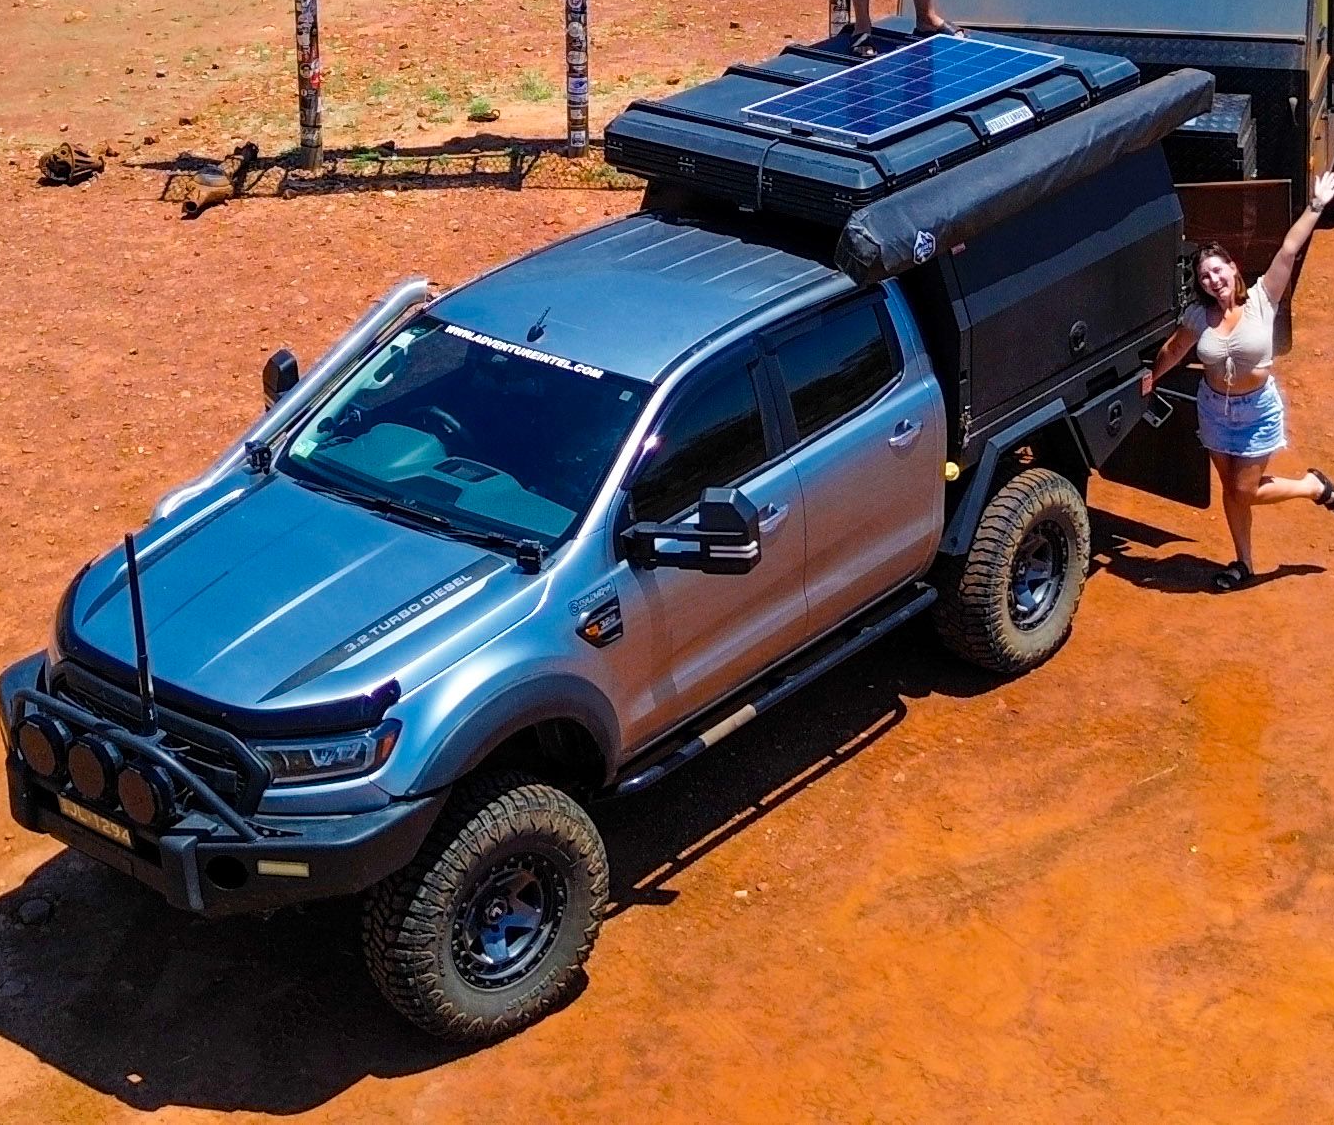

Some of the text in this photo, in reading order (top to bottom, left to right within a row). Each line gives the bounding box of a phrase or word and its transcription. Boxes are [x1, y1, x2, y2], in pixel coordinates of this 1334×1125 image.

[343, 574, 473, 653] 3.2 TURBO DIESEL
